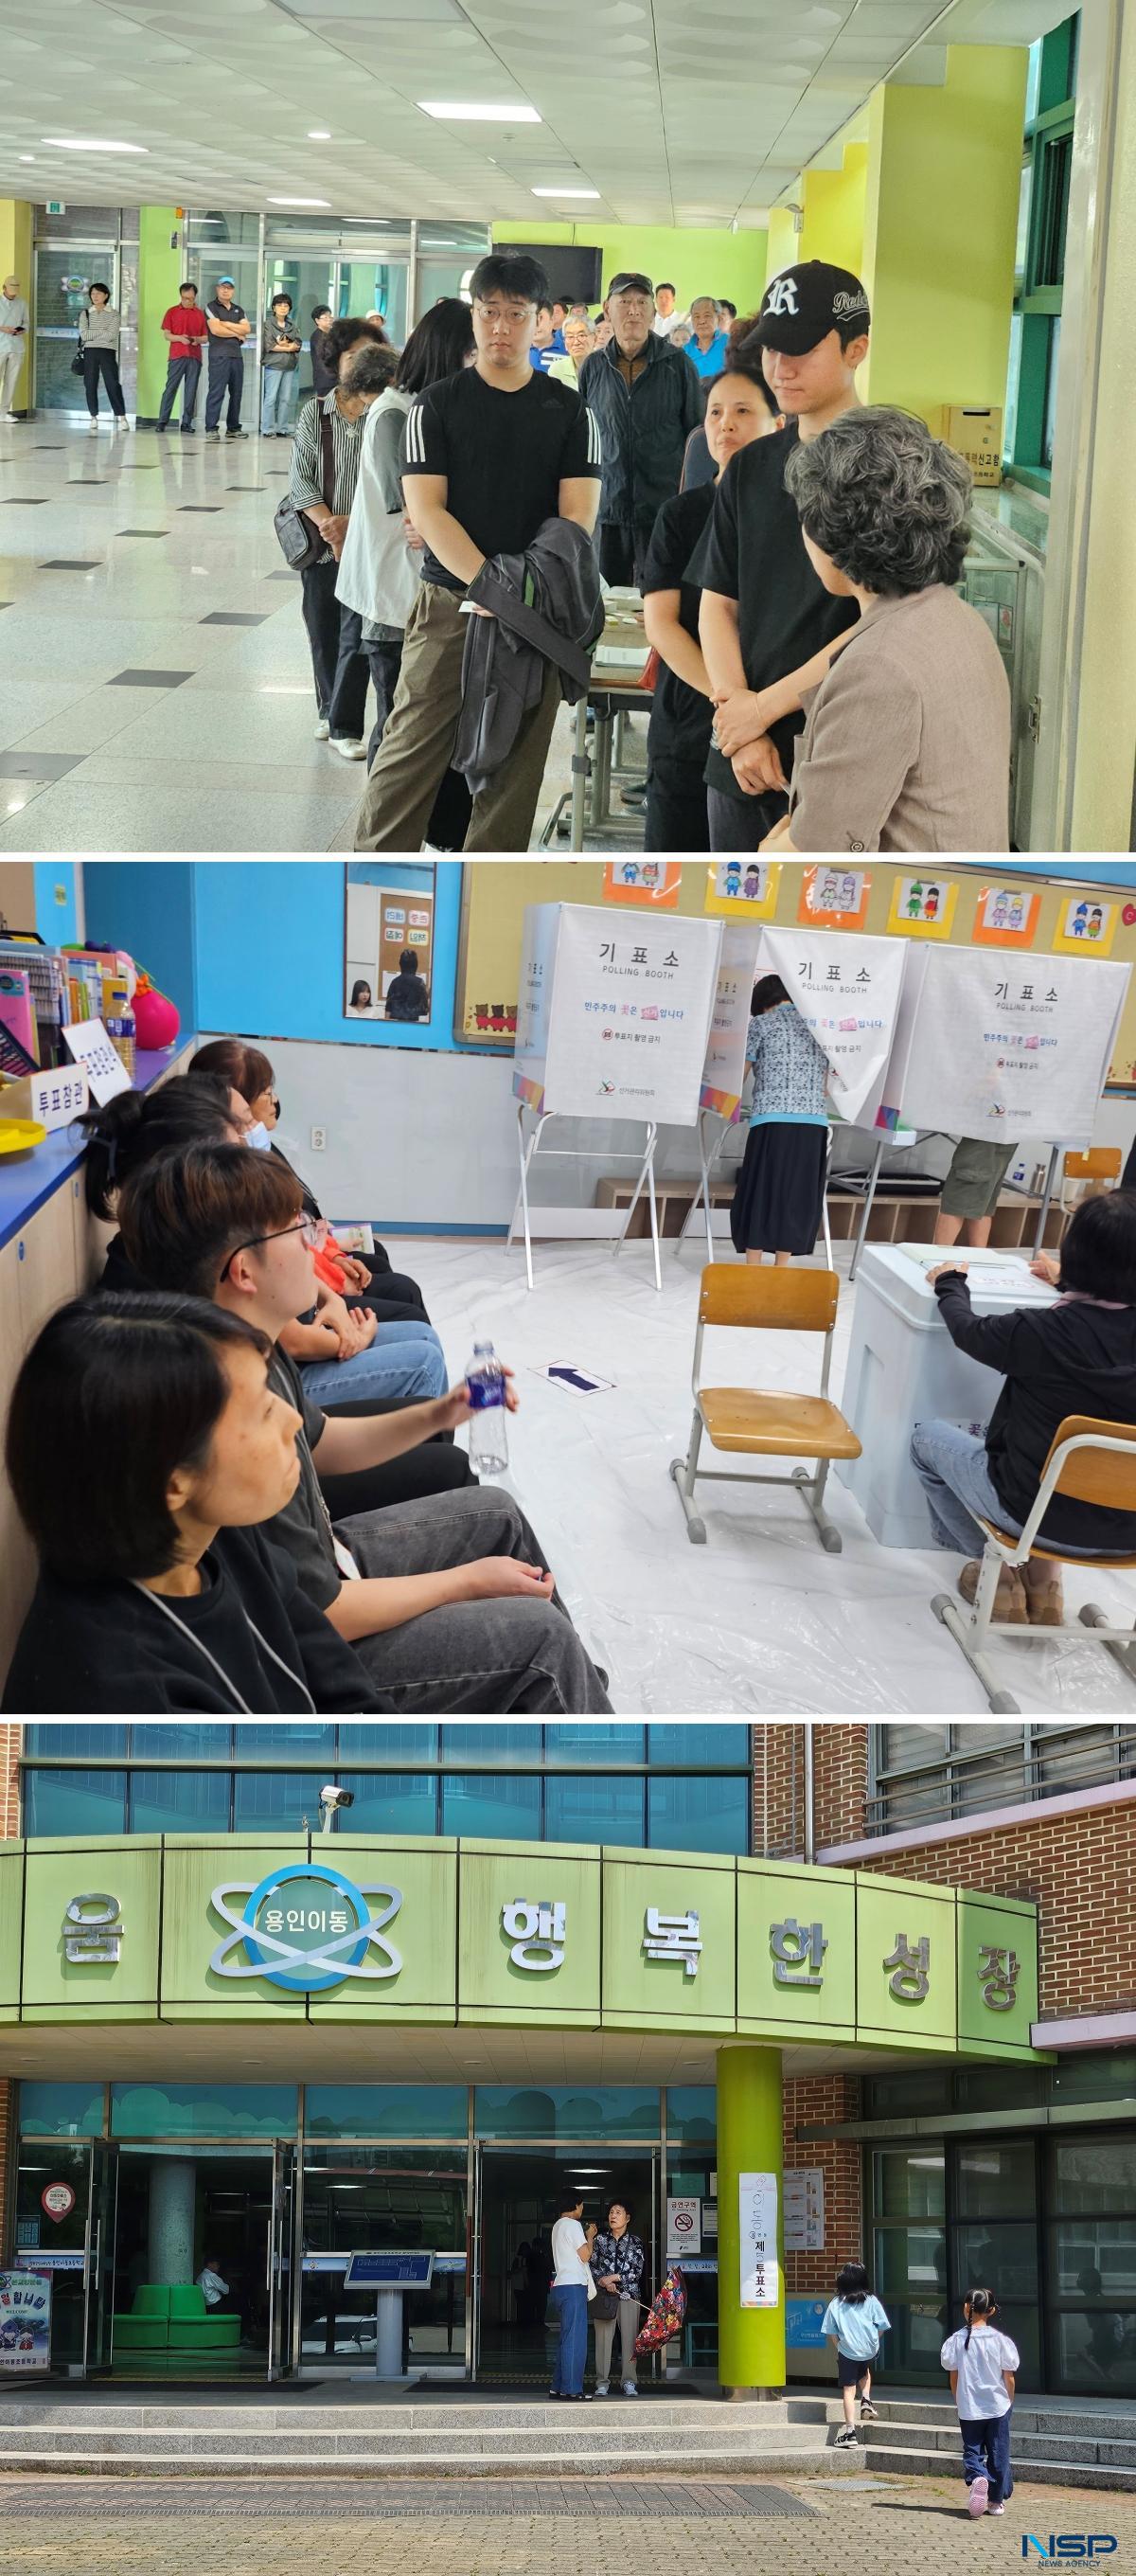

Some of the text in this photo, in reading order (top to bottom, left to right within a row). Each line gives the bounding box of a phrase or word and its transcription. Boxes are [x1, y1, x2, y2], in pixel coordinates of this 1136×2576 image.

[763, 277, 799, 316] R
[602, 965, 675, 979] POLLING BOOTH
[802, 982, 835, 993] POLLING
[584, 1001, 616, 1013] 민주주의
[621, 1004, 638, 1016] 꽃은
[996, 1002, 1054, 1013] POLLING BOOTH
[614, 1032, 661, 1044] 투표지 촬영 금지
[62, 1893, 124, 1963] 움
[264, 1910, 349, 1933] 용인이동
[0, 2291, 46, 2310] 영합니다
